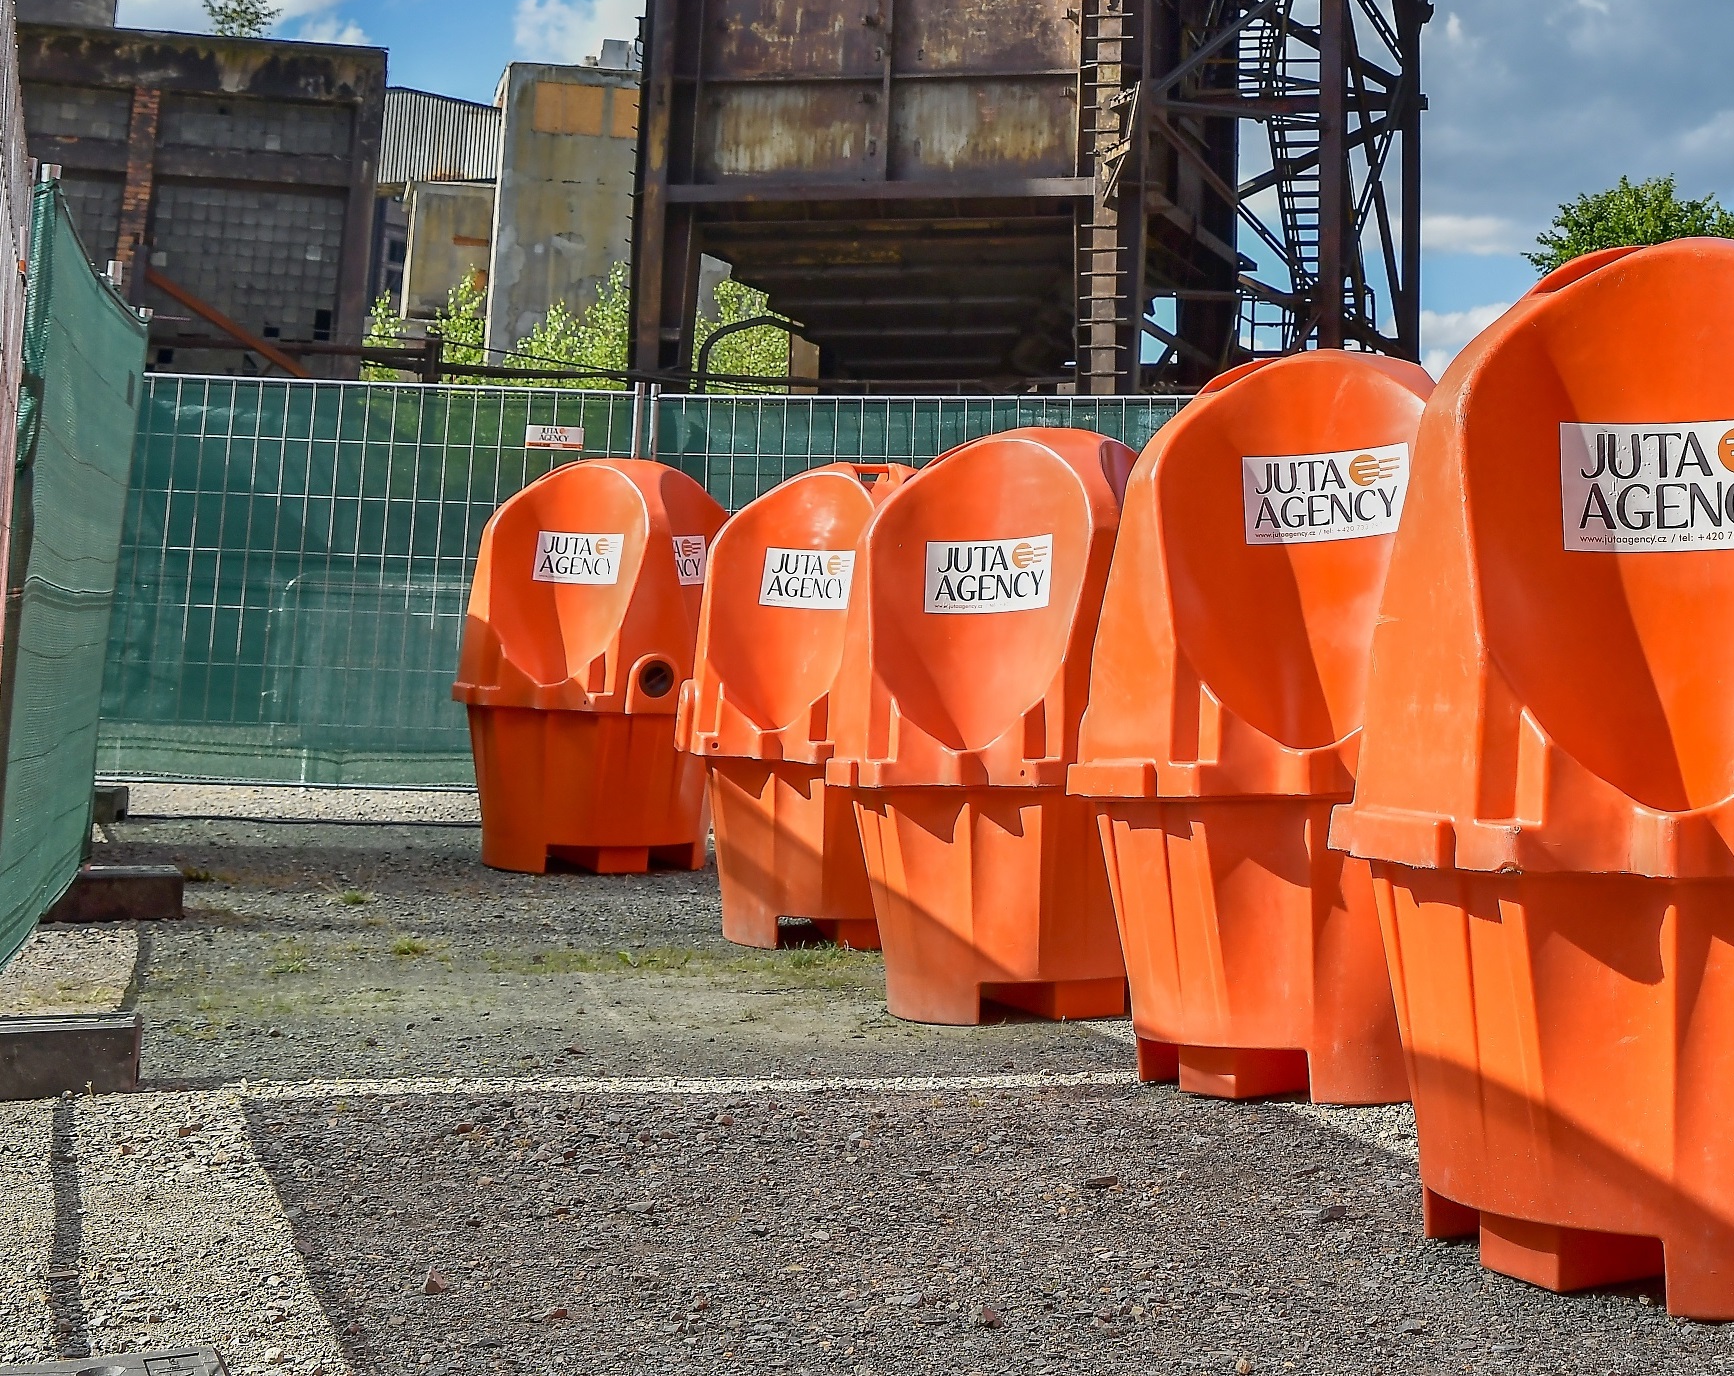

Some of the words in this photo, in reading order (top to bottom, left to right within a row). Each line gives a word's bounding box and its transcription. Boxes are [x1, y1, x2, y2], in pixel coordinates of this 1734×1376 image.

[1580, 431, 1714, 480] JUTA
[1255, 458, 1347, 495] JUTA
[1254, 485, 1398, 529] AGENCY
[543, 536, 592, 555] JUTA
[1254, 530, 1316, 539] www.jutaagency.cz
[1579, 533, 1667, 545] www.jutaagency.cz
[1678, 532, 1694, 542] tel:
[1697, 531, 1725, 541] +420
[539, 554, 611, 576] AGENCY
[771, 553, 824, 576] JUTA
[937, 545, 1009, 573] JUTA
[766, 575, 847, 599] AGENCY
[934, 569, 1045, 602] AGENCY
